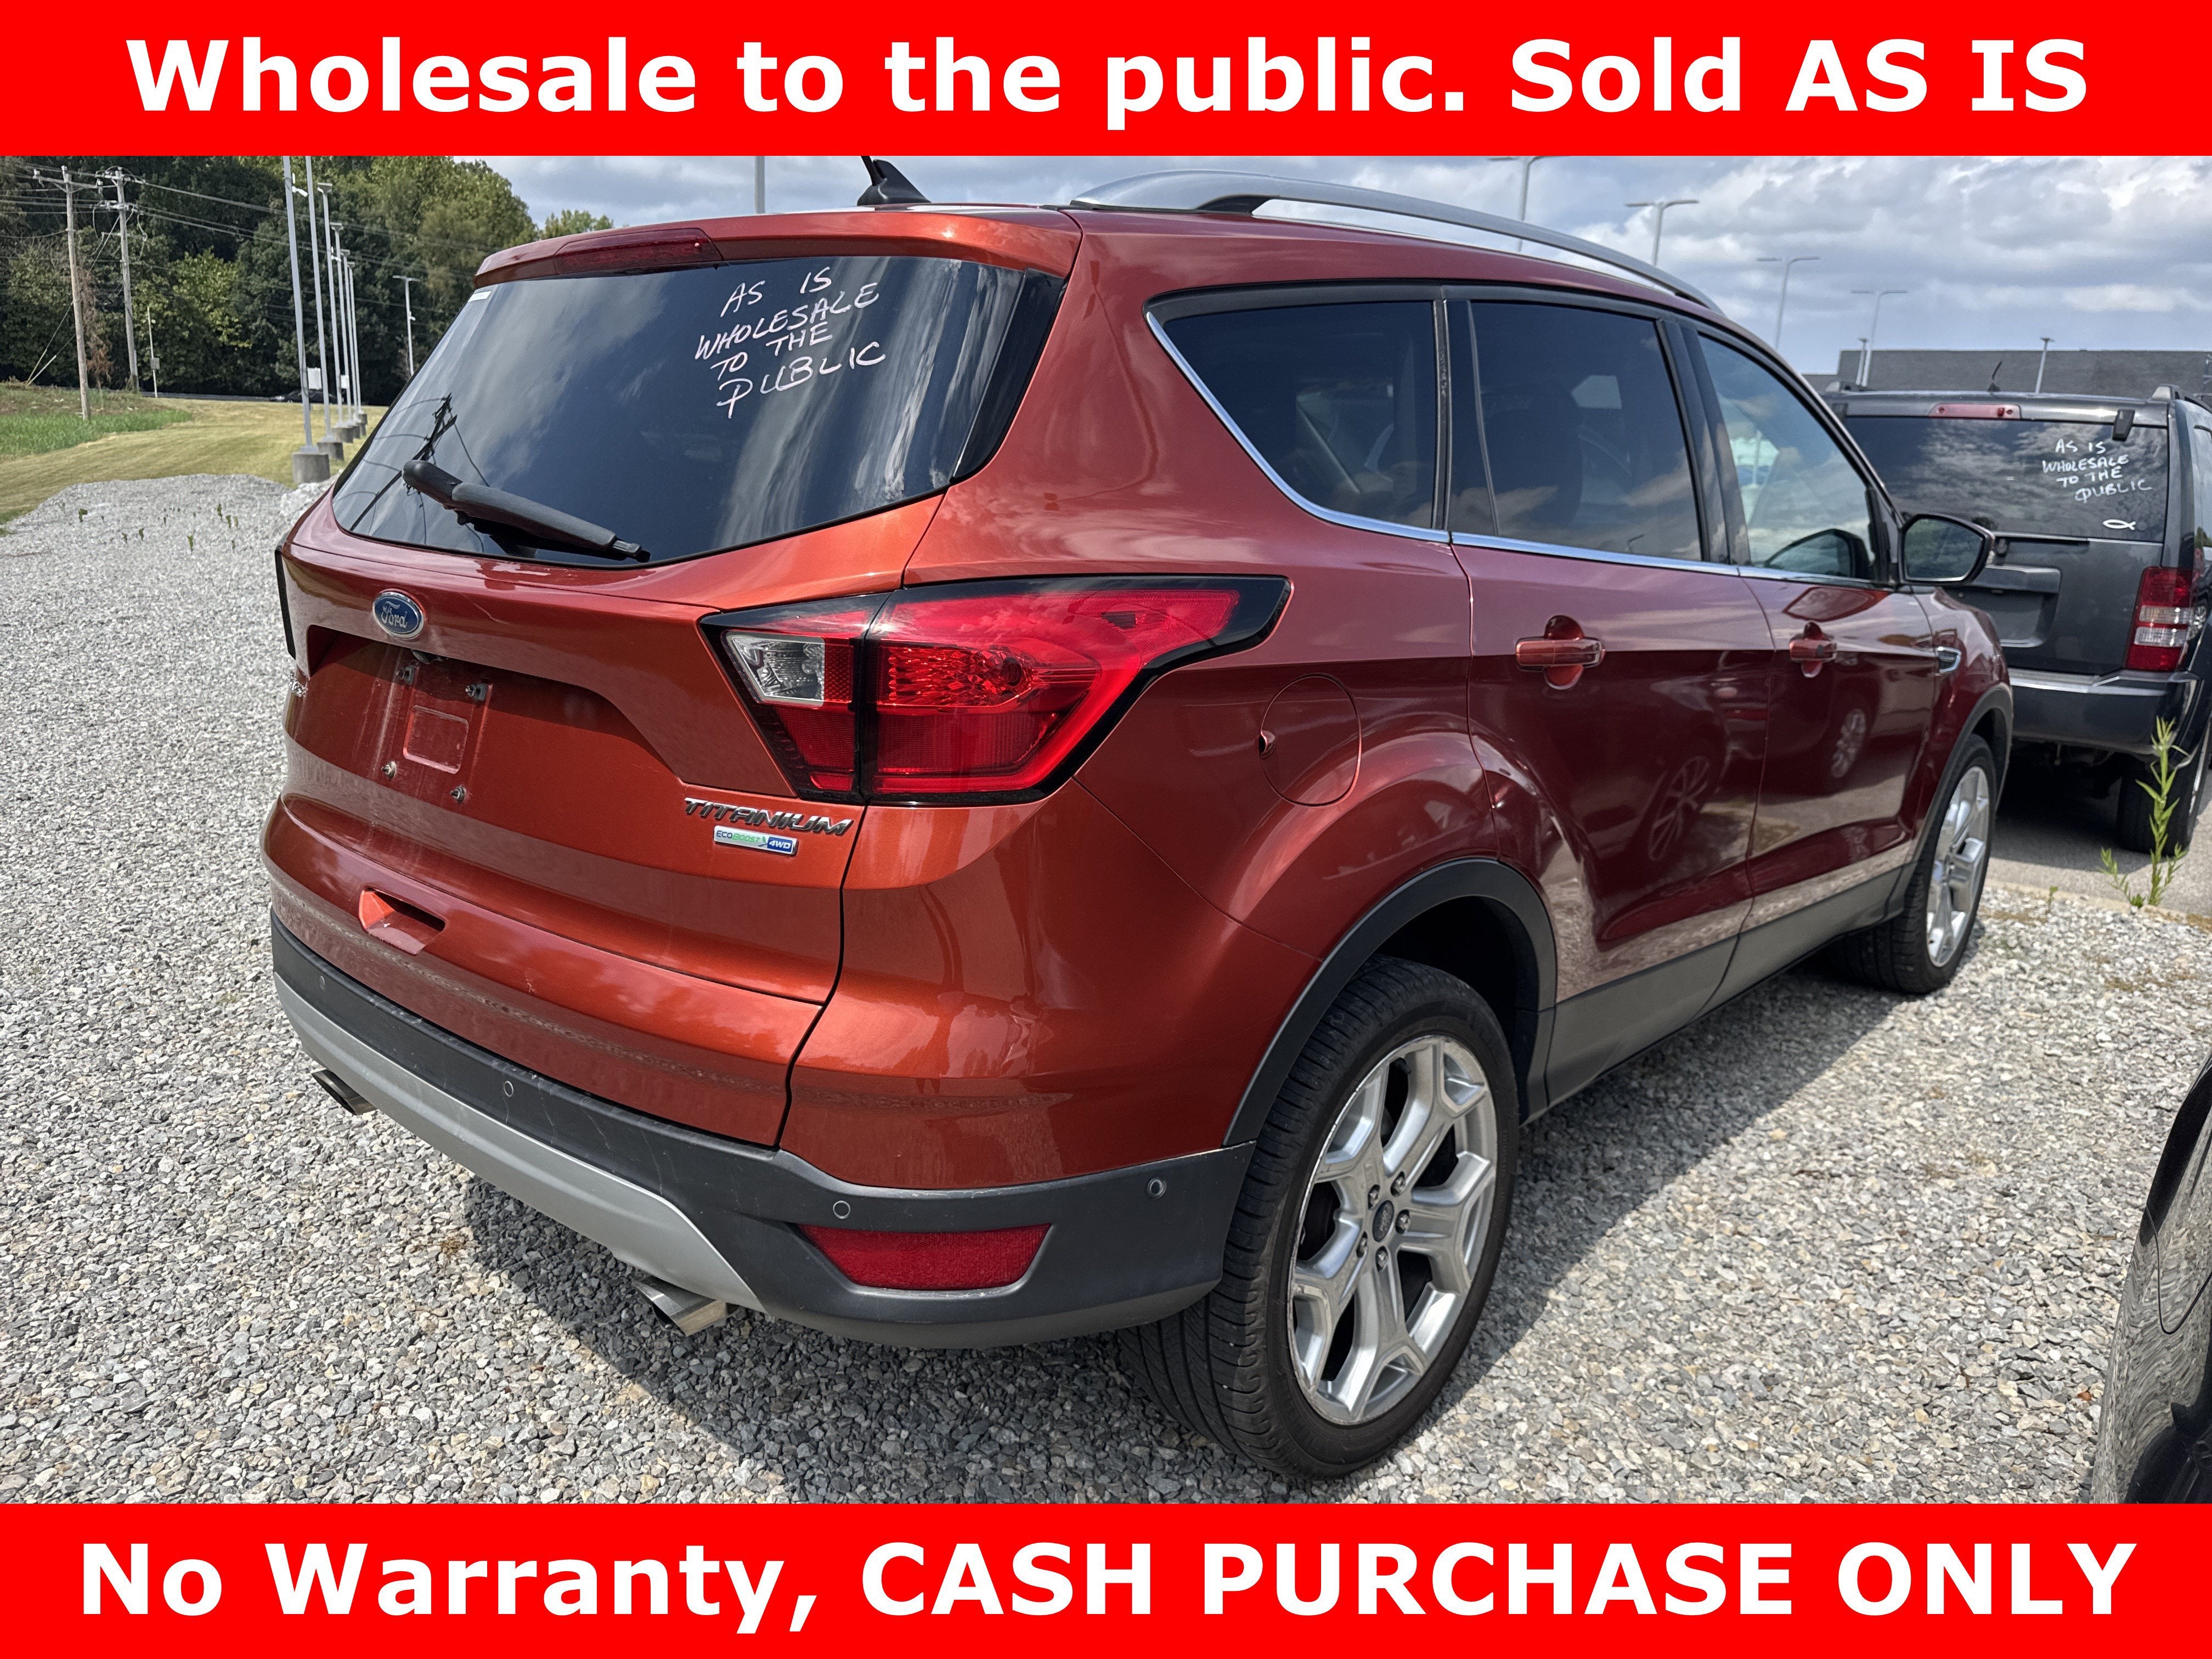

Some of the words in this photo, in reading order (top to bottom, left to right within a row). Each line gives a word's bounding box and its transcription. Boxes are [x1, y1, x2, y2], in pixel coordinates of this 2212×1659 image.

[720, 280, 765, 318] AS
[800, 267, 832, 294] IS
[695, 282, 879, 360] WHOLESALE
[710, 352, 748, 381] TO
[766, 321, 833, 356] THE
[716, 341, 885, 419] PUBLIC
[2055, 438, 2078, 454] AS
[2088, 441, 2106, 454] IS
[2042, 454, 2129, 473] WHOLESALE
[2056, 475, 2079, 487] TO
[2085, 466, 2123, 482] THE
[2074, 479, 2153, 504] PUBLIC
[381, 601, 408, 628] Ford
[684, 797, 854, 835] TITANIUM
[769, 839, 792, 850] 4WD
